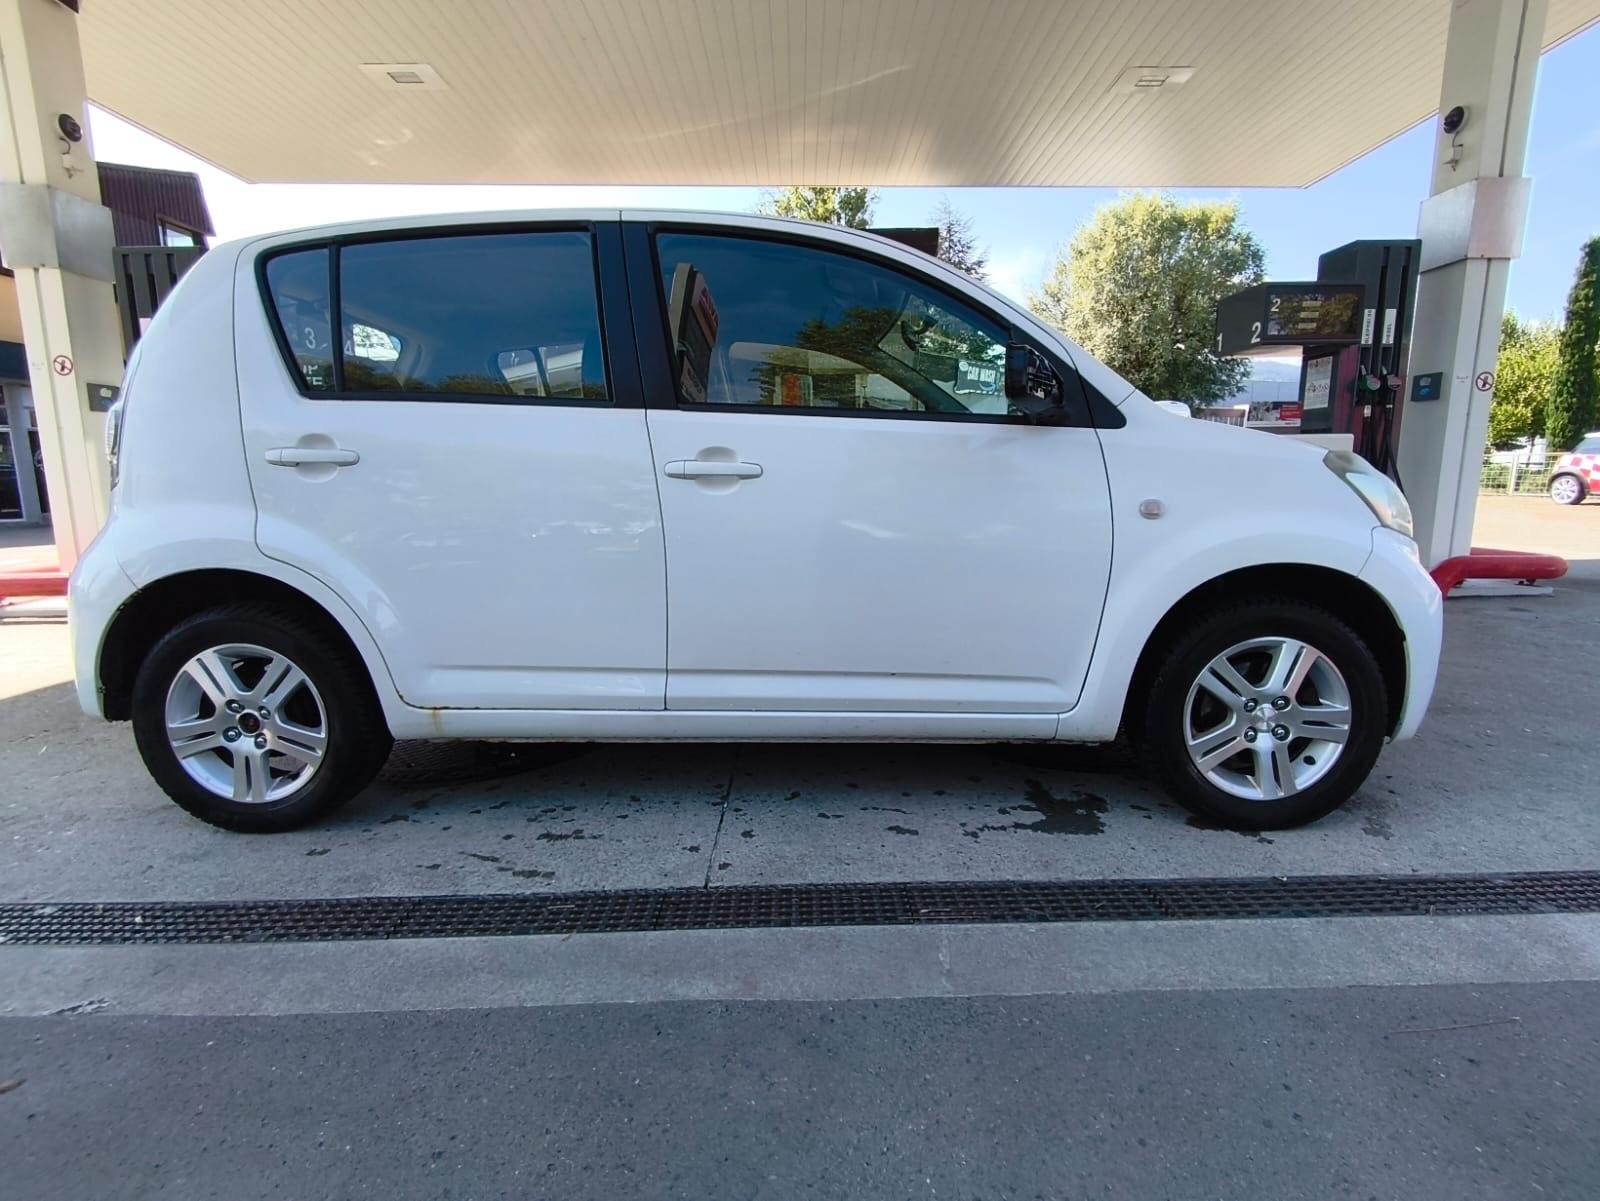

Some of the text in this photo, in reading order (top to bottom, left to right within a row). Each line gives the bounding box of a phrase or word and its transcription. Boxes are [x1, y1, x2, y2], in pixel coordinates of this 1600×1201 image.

[1270, 297, 1281, 312] 2
[304, 327, 316, 350] 3
[1250, 321, 1262, 344] 2
[1216, 333, 1223, 353] 1
[968, 366, 996, 383] CAR WASH
